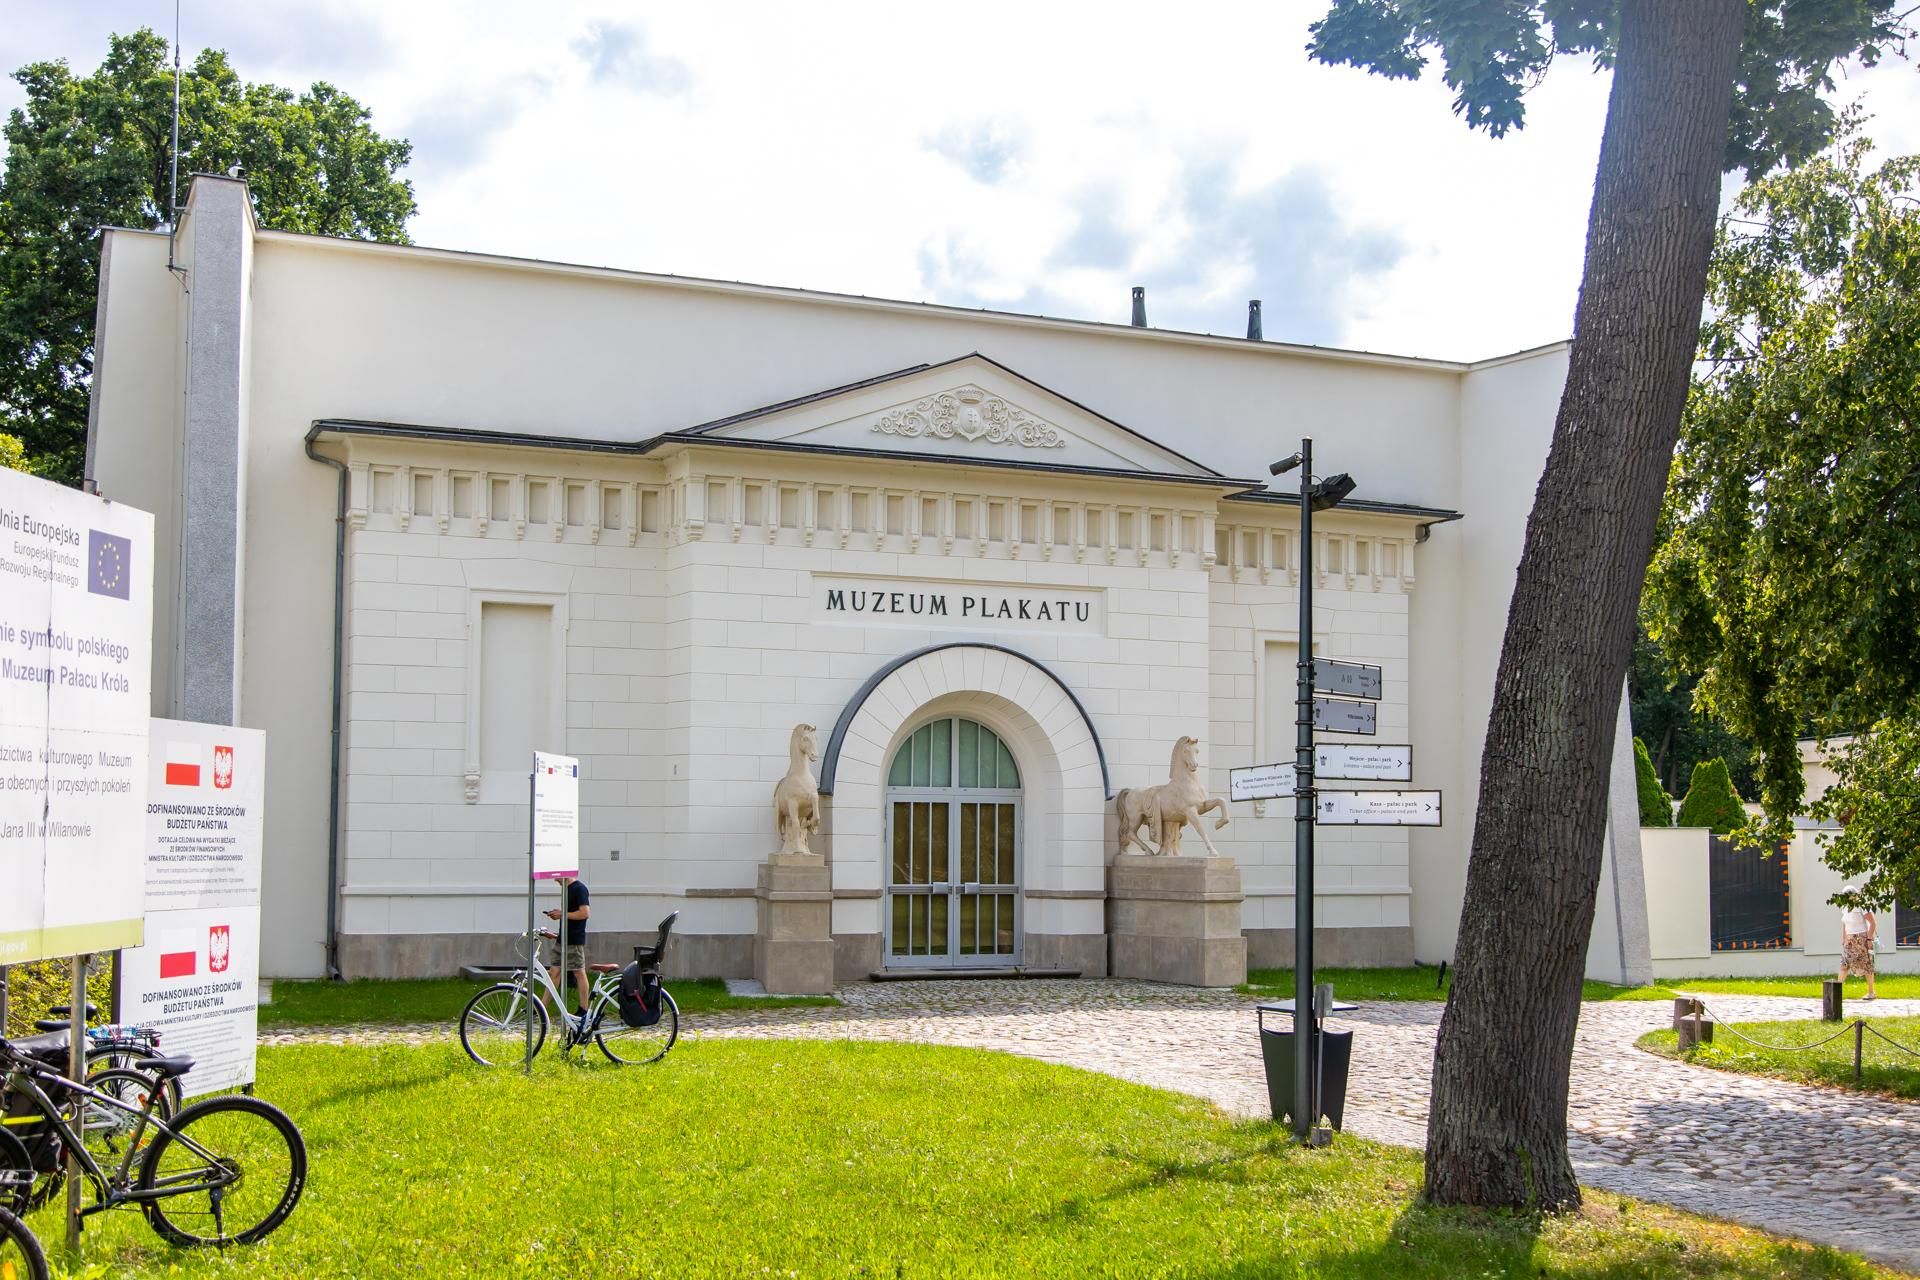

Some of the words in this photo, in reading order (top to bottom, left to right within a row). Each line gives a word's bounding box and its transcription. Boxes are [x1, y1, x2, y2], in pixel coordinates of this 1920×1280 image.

[23, 515, 80, 546] Europejska
[14, 541, 53, 562] Europejski
[53, 550, 79, 568] Fundusz
[0, 558, 31, 578] Rozwoju
[33, 565, 79, 588] Regionalnego
[826, 589, 948, 616] MUZEUM
[962, 596, 1089, 622] PLAKATU
[20, 627, 73, 652] symbolu
[78, 636, 129, 664] polskiego
[2, 658, 55, 684] Muzeum
[60, 666, 98, 689] Pałacu
[101, 671, 129, 693] Króla
[40, 747, 93, 769] kulturowego
[99, 751, 132, 768] Muzeum
[8, 774, 50, 795] obecnych
[57, 777, 100, 796] przyszłych
[102, 778, 131, 797] pokoleń
[147, 803, 207, 817] DOFINANSOWANO
[207, 806, 215, 817] ZE
[215, 803, 246, 817] ŚRODKÓW
[0, 821, 24, 839] Jana
[48, 821, 92, 838] Wilanowie
[166, 817, 196, 829] BUDŻETU
[197, 817, 228, 830] PAŃSTWA
[142, 985, 203, 1004] DOFINANSOWANO
[203, 985, 211, 995] ZE
[211, 979, 242, 994] ŚRODKÓW
[163, 1000, 193, 1014] BUDŻETU
[193, 996, 225, 1010] PAŃSTWA
